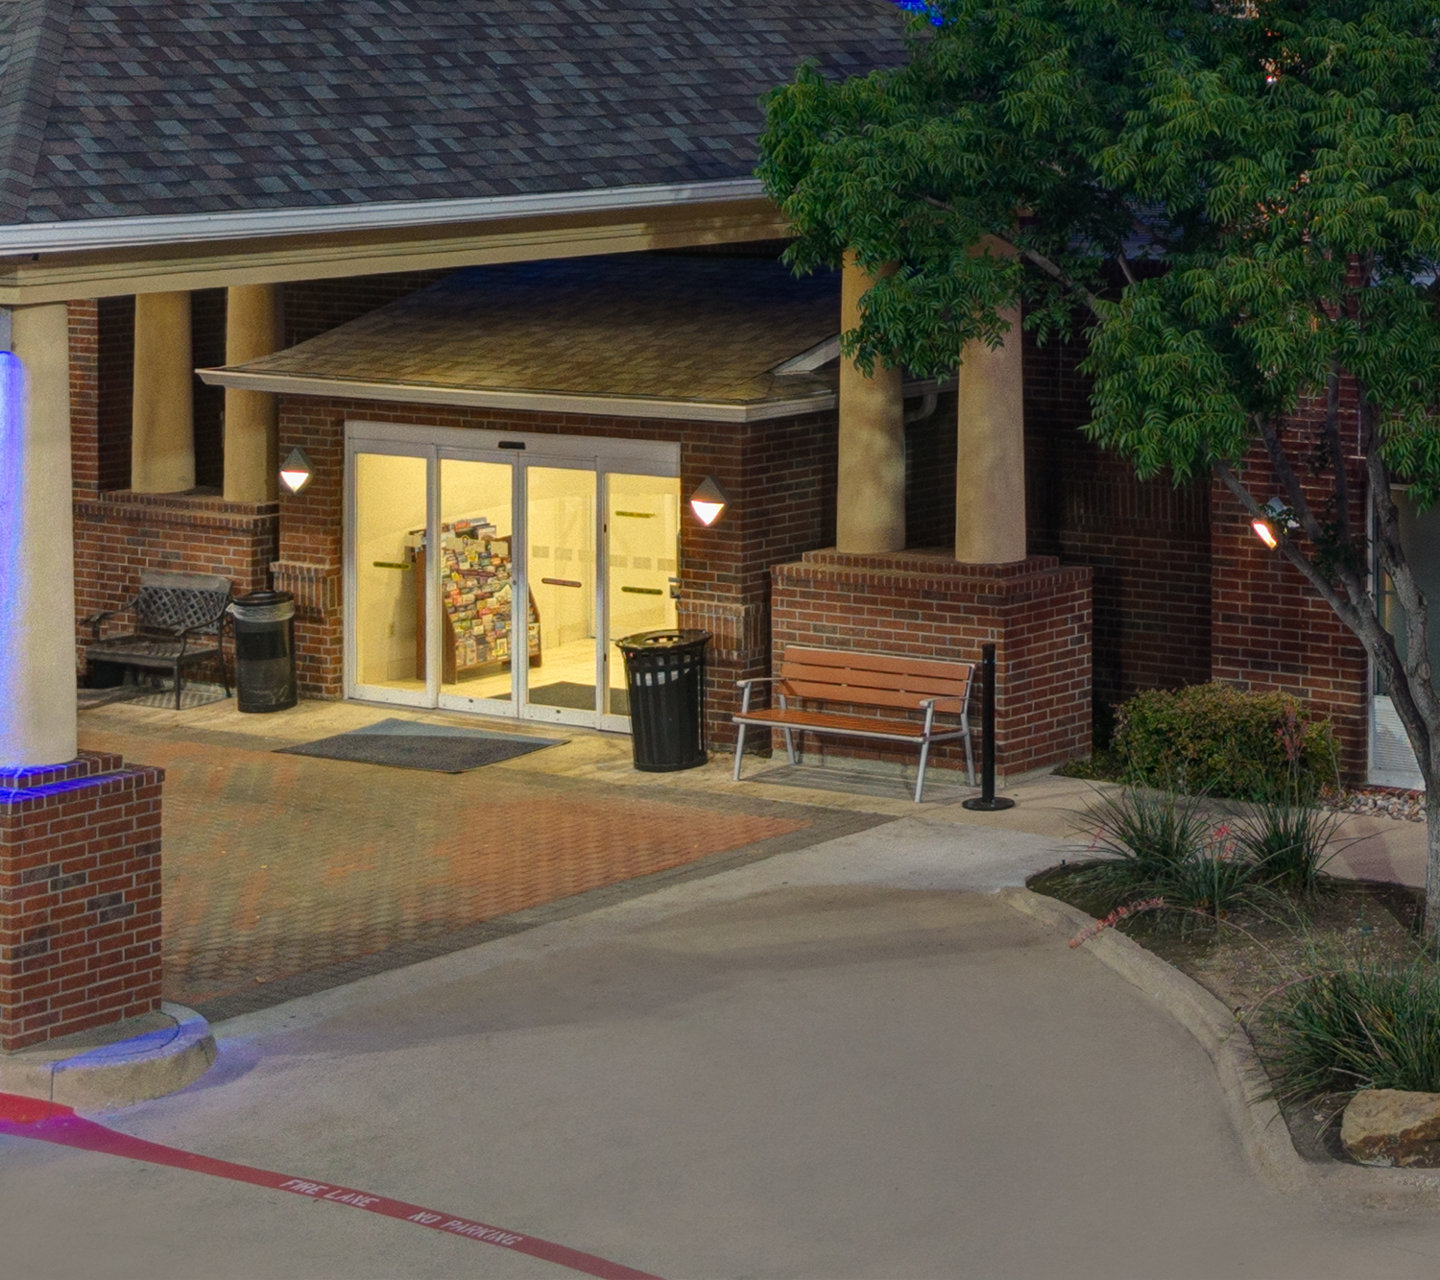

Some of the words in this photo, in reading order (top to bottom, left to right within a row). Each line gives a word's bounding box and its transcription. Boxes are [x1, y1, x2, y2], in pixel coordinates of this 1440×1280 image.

[280, 1178, 329, 1196] FIRE
[323, 1189, 380, 1208] LANE
[408, 1211, 441, 1225] NO
[440, 1219, 523, 1246] PARKING
